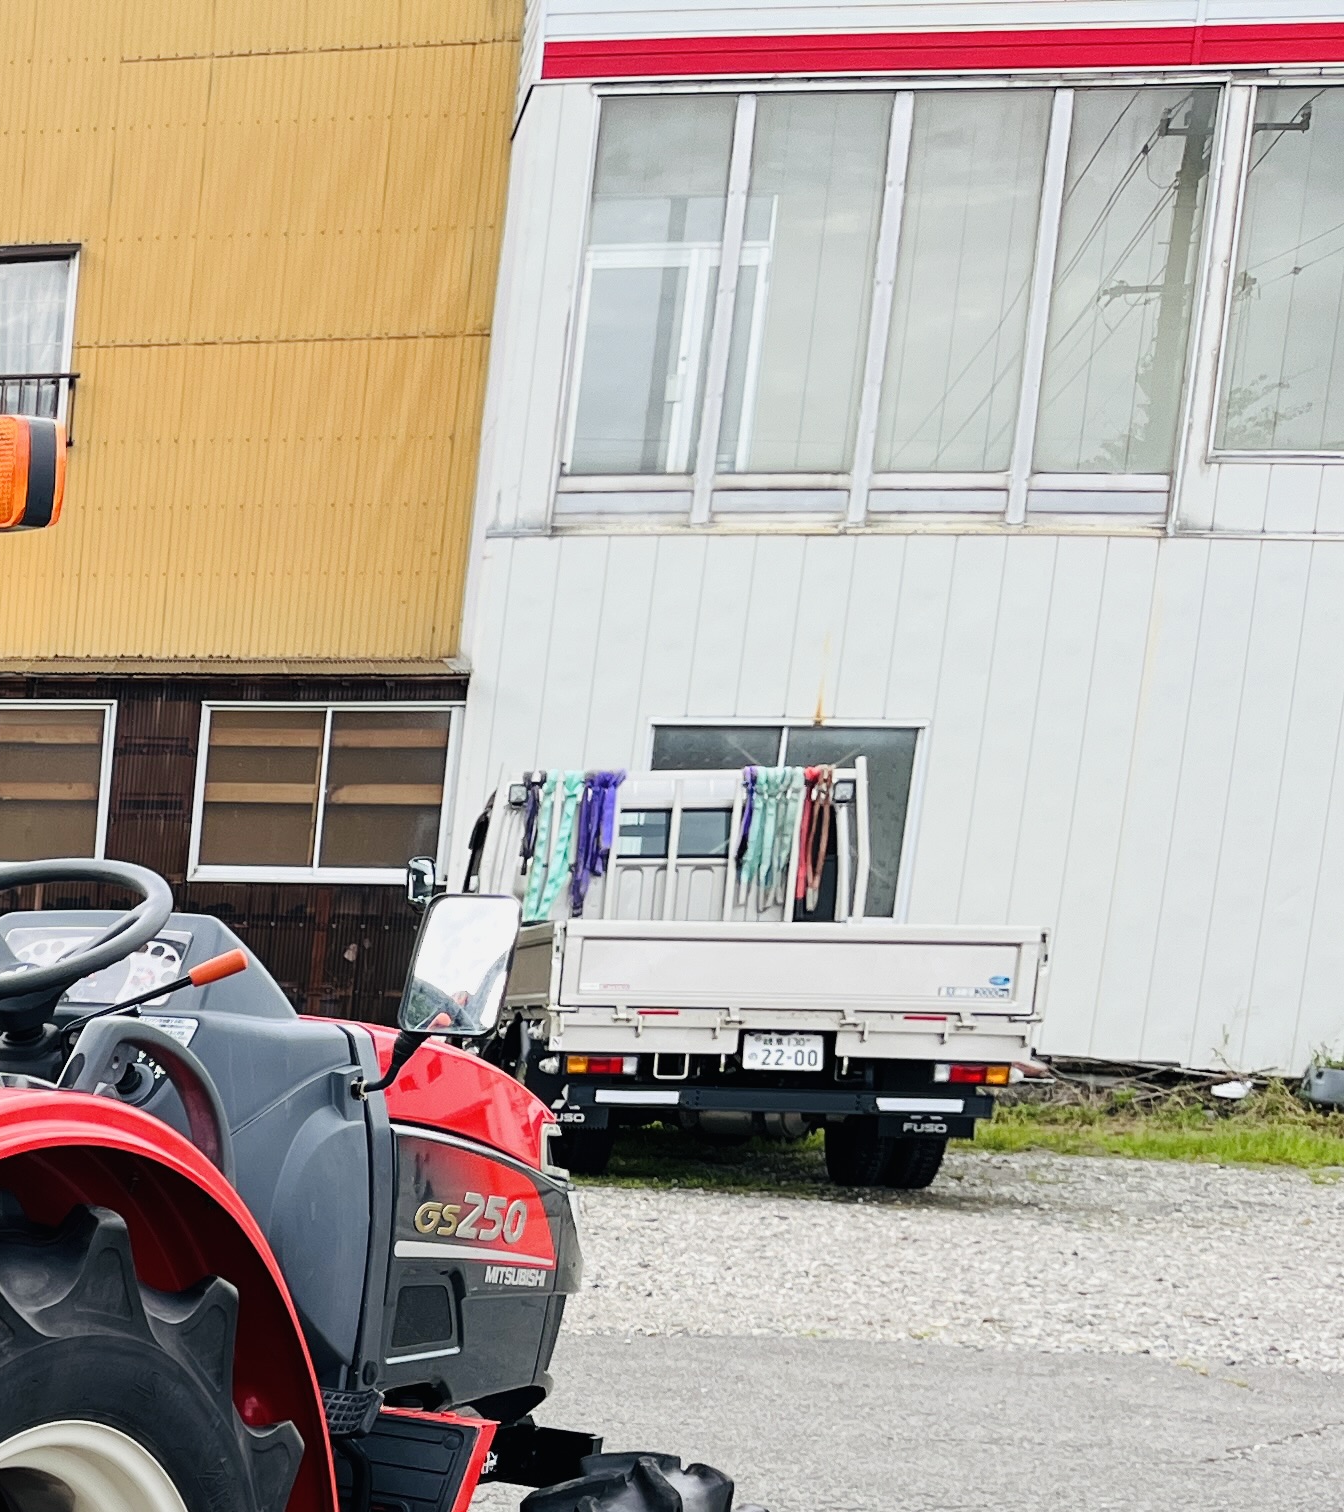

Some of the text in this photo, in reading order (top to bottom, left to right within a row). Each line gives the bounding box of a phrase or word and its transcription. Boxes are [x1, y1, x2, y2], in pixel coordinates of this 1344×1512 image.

[761, 1049, 818, 1067] 22-00
[554, 1112, 585, 1123] USO
[903, 1122, 948, 1134] FUSO
[414, 1191, 527, 1244] GS250
[484, 1265, 547, 1288] MITSUBISHI
